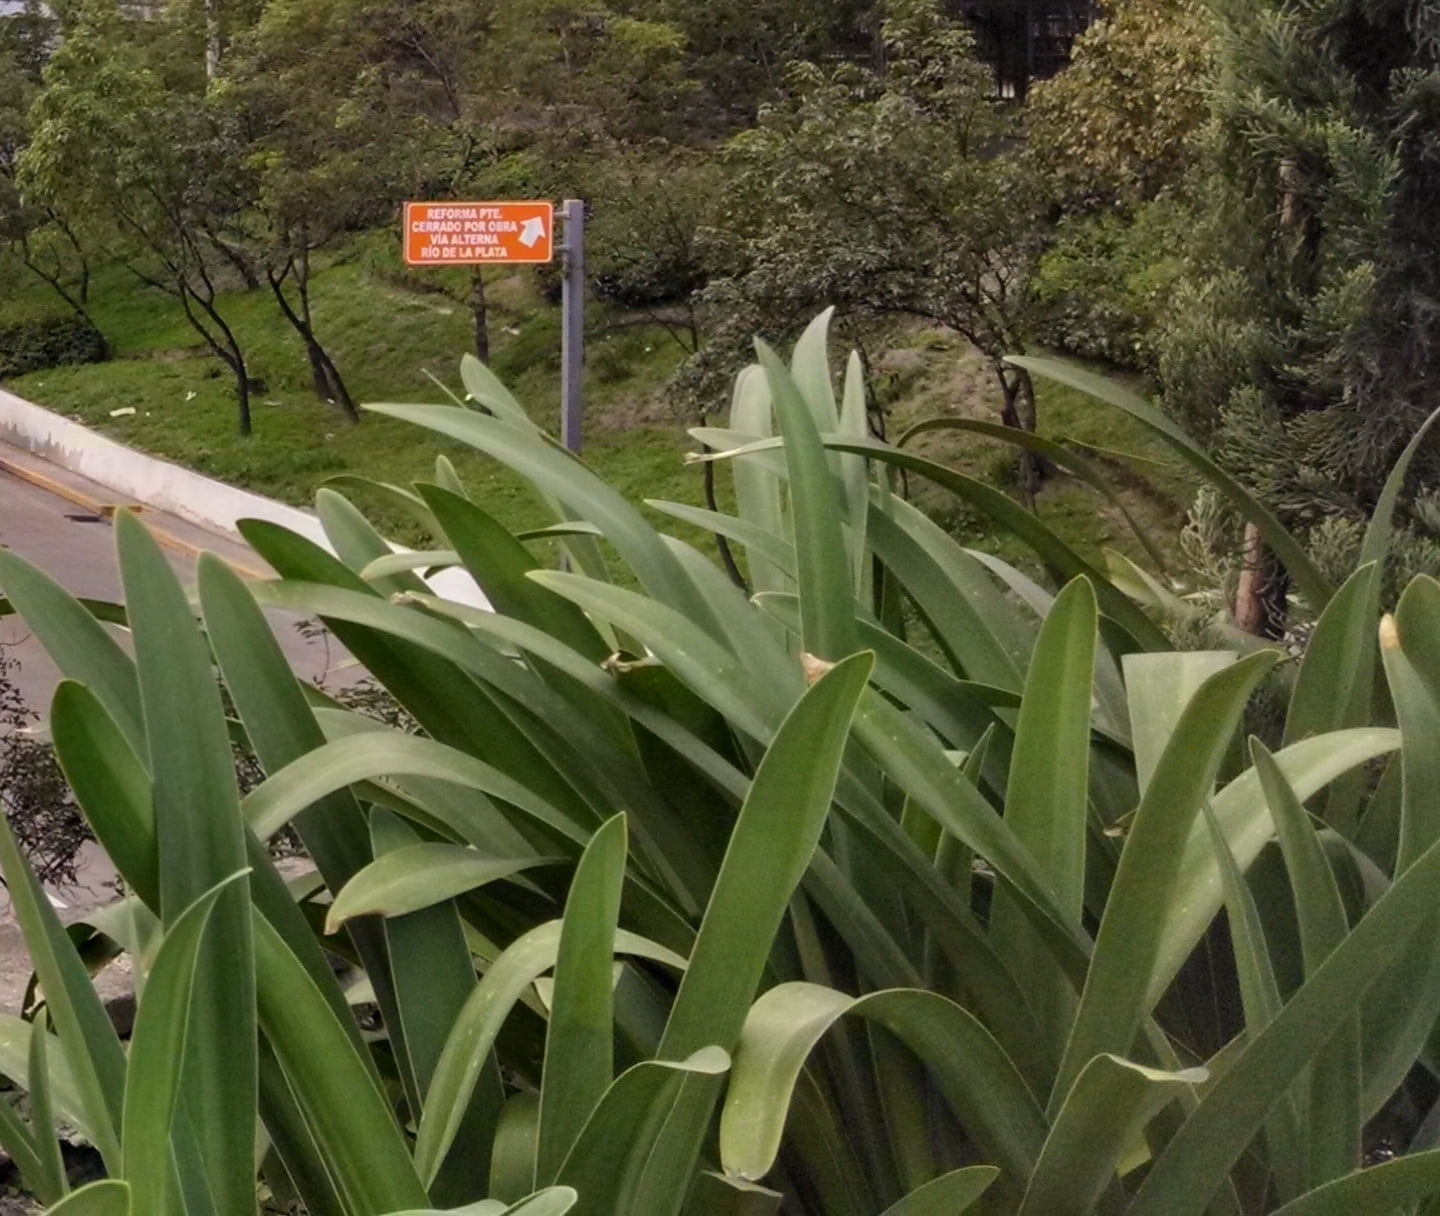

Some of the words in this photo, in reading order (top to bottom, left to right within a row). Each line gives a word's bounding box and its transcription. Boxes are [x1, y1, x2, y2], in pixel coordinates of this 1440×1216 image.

[427, 208, 477, 219] REFORMA
[480, 208, 502, 219] PTE.
[412, 221, 461, 232] CERRADO
[464, 221, 486, 232] POR
[488, 221, 517, 232] OBRA
[451, 234, 499, 244] ALTERNA
[421, 245, 439, 257] RÍO
[442, 247, 456, 257] DE
[459, 247, 473, 257] LA
[475, 247, 508, 257] PLATA
